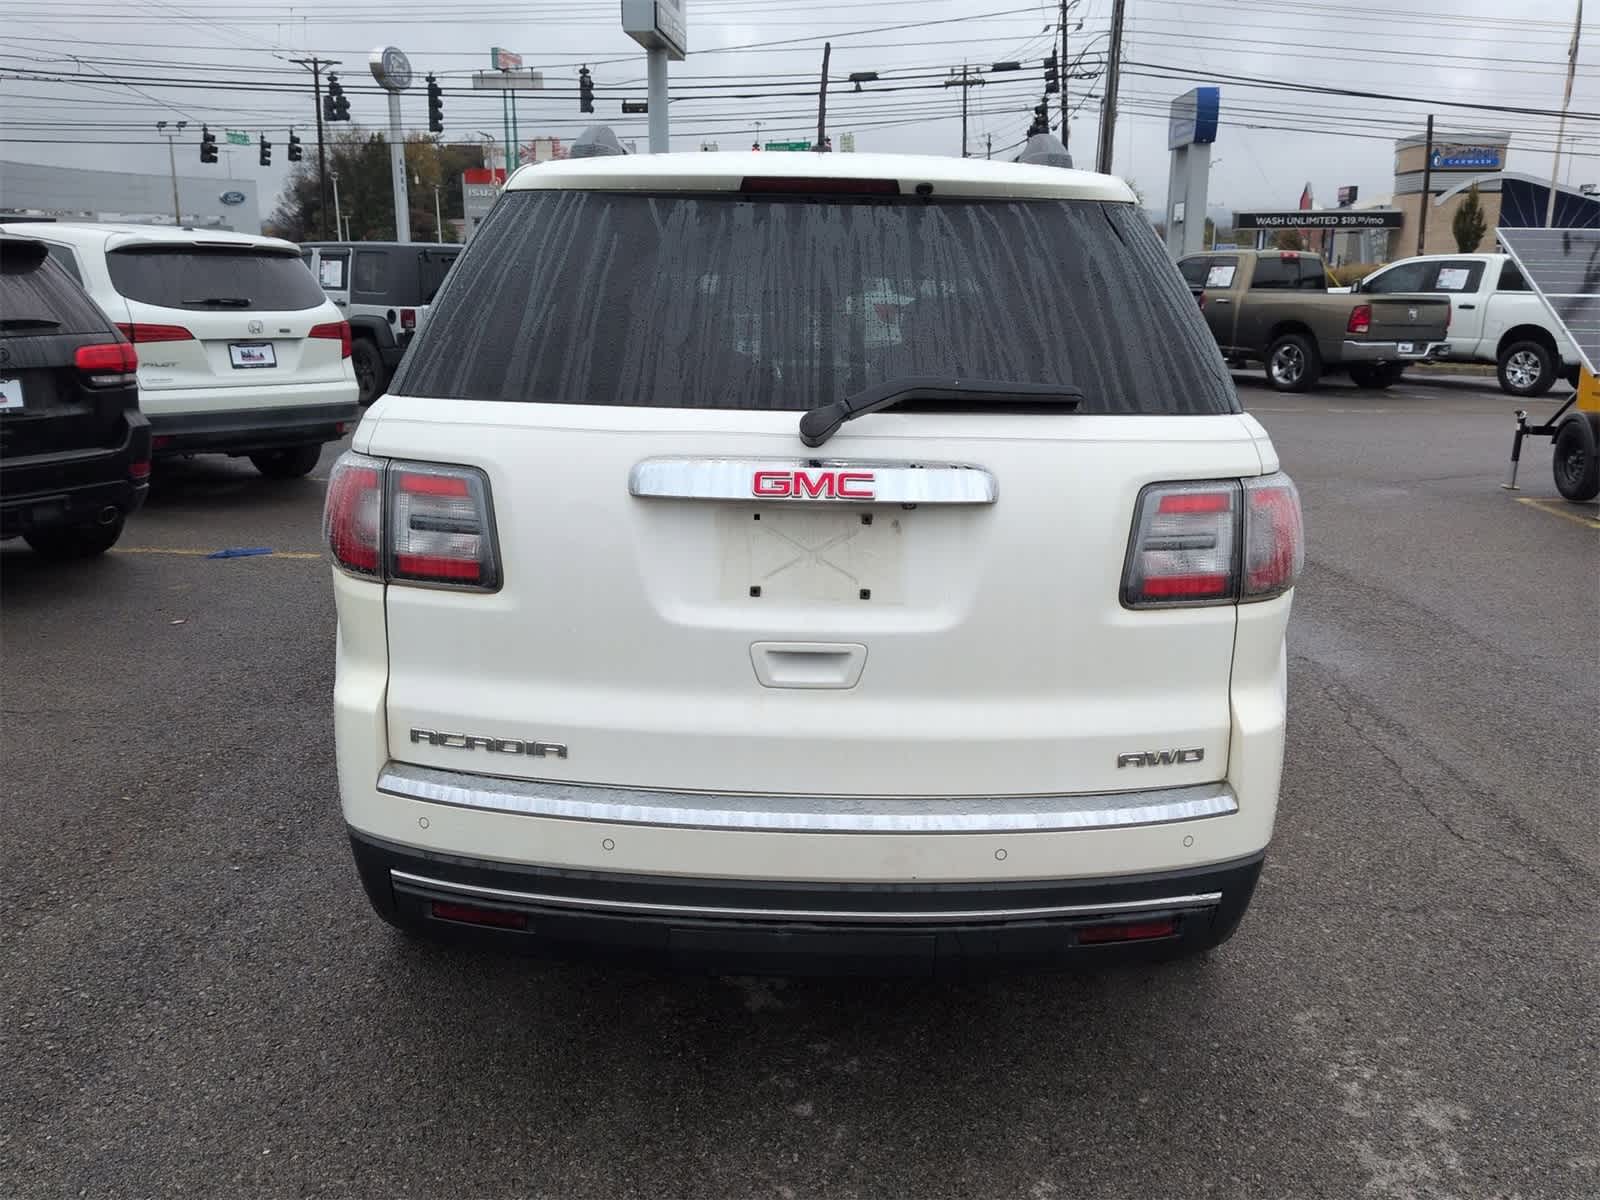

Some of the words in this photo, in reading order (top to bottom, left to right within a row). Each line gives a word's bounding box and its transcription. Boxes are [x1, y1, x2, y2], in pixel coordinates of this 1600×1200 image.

[1256, 217, 1285, 225] WASH
[1287, 216, 1339, 225] UNLIMITED
[752, 471, 876, 499] GMC
[410, 727, 568, 759] ACADIA
[1117, 746, 1204, 768] AWD
